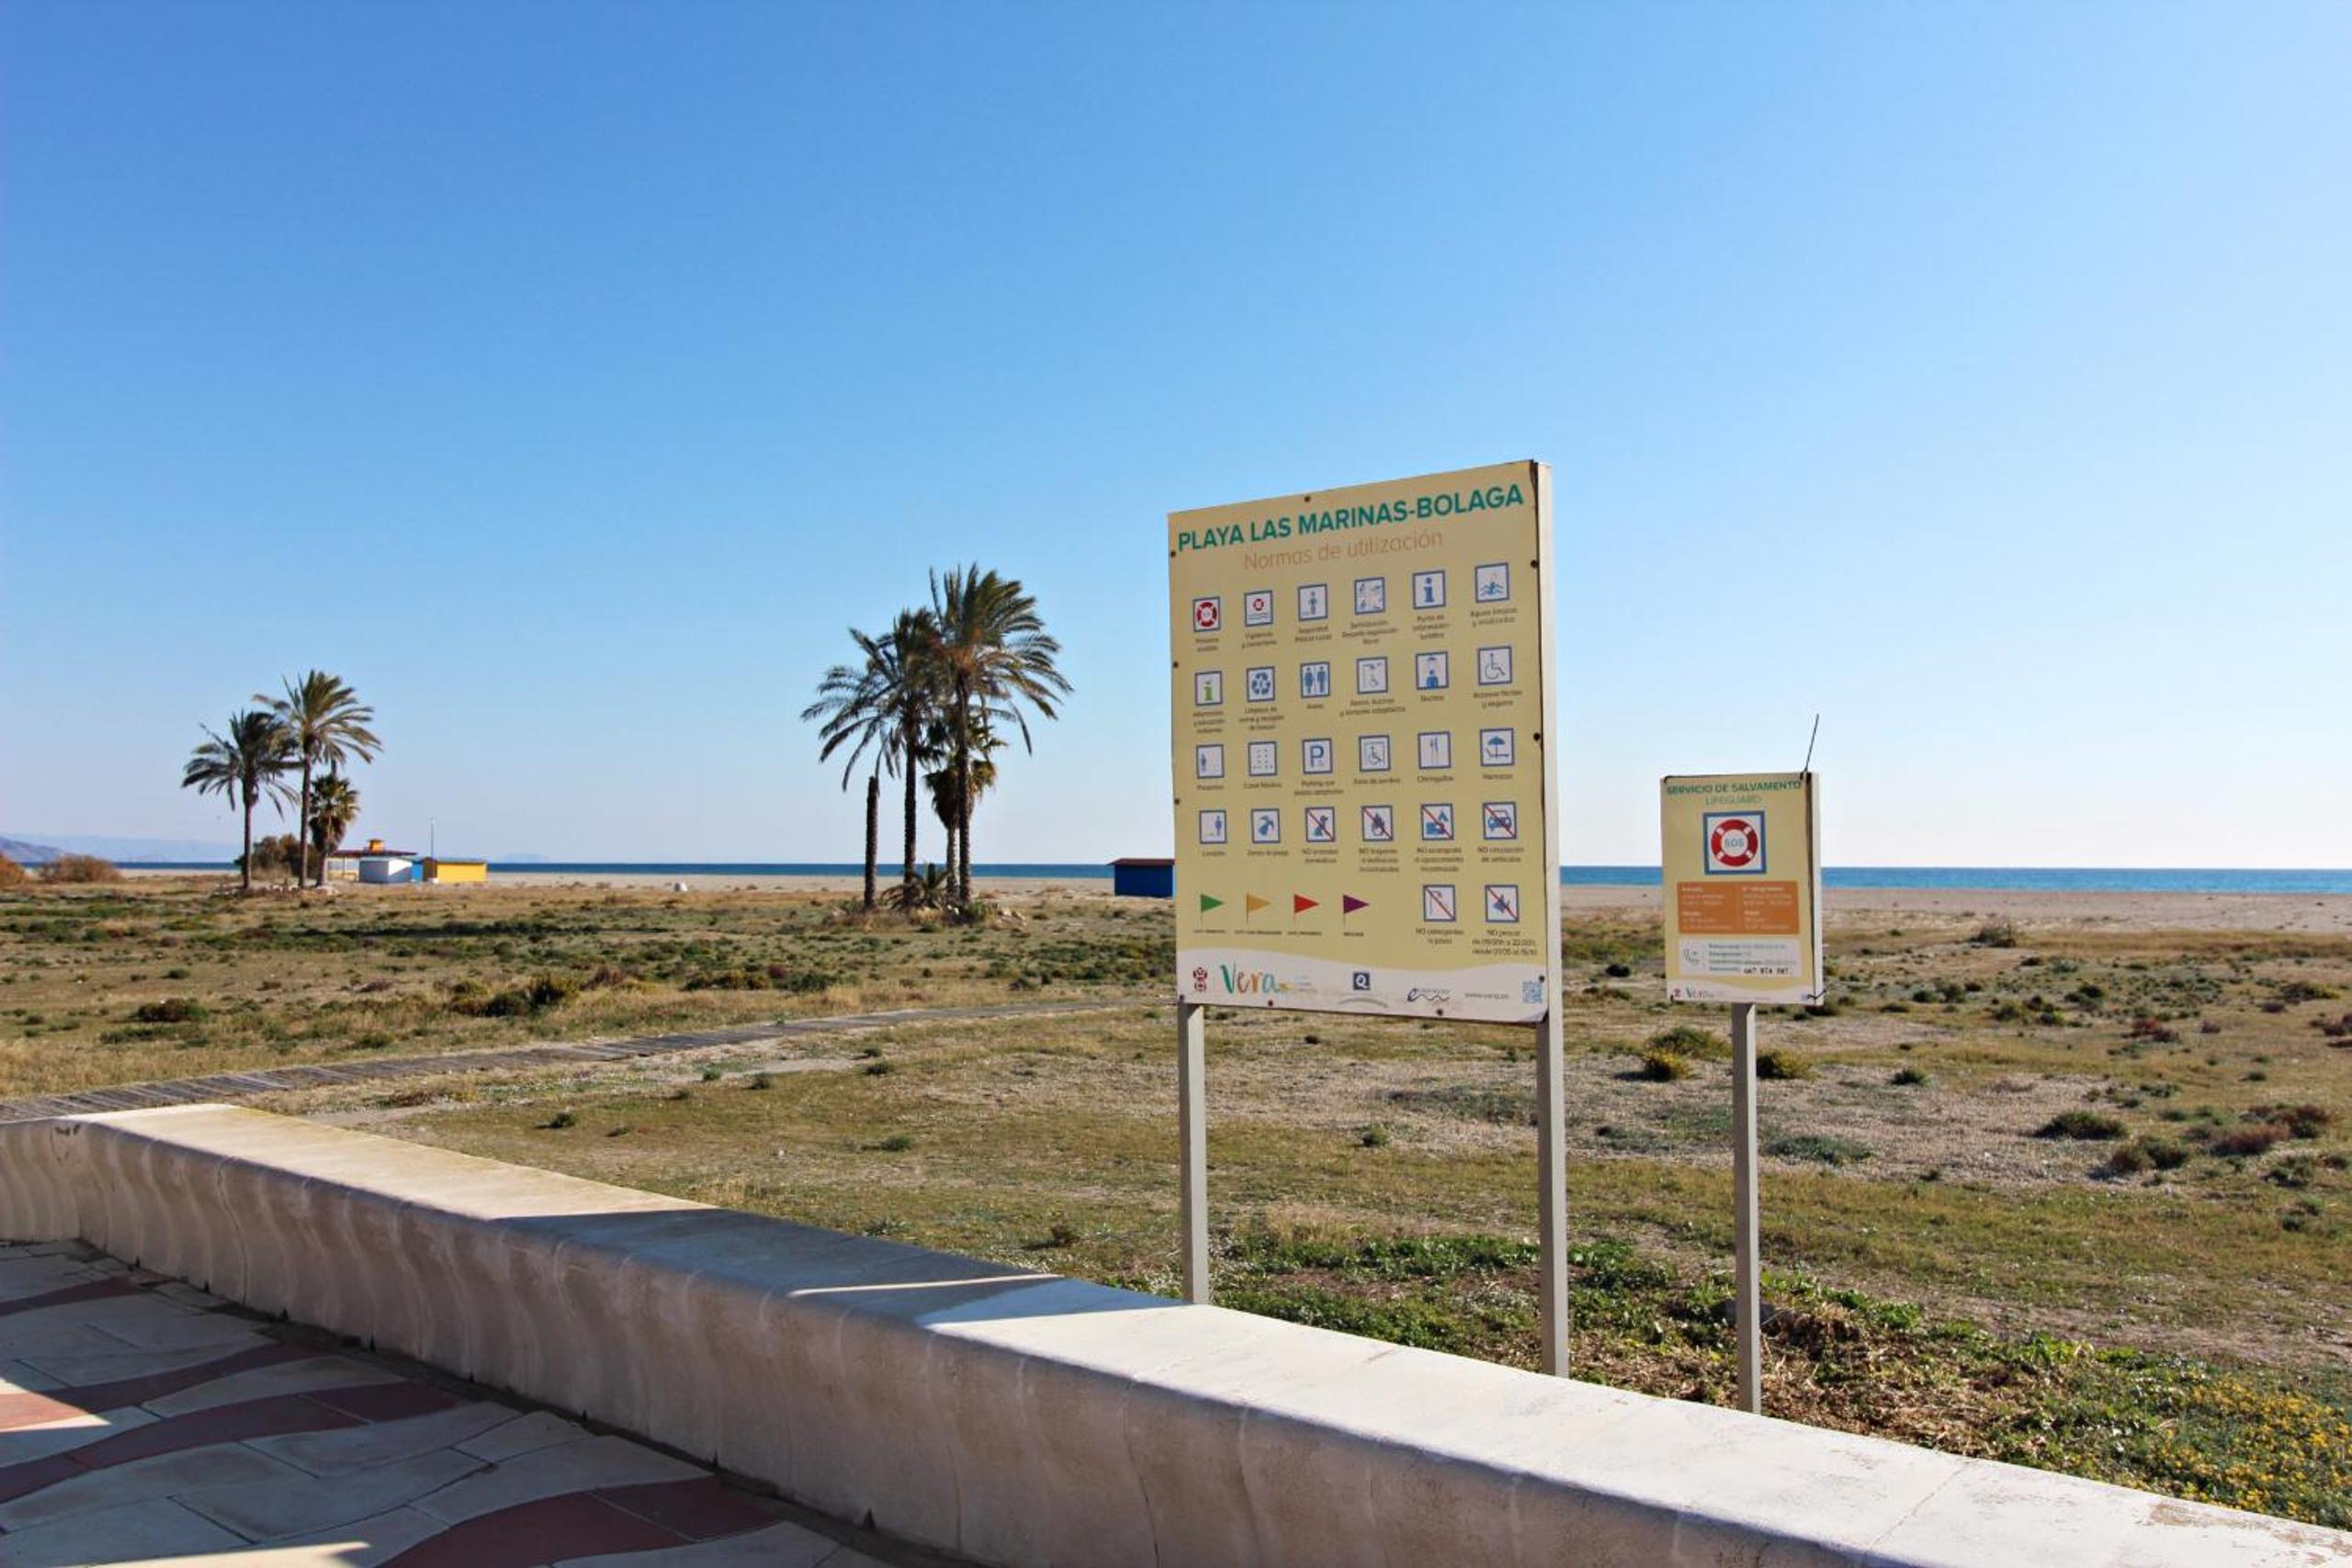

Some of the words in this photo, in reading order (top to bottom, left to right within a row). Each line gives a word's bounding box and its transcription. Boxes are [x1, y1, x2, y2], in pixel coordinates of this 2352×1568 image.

[1177, 523, 1244, 552] PLAYA
[1250, 516, 1292, 542] LAS
[1298, 484, 1524, 535] MARINAS-BOLAGA
[1244, 547, 1312, 570] Normas
[1318, 541, 1340, 562] de
[1347, 528, 1443, 558] utilización
[1667, 784, 1712, 795] SERVICIO
[1714, 783, 1728, 793] DE
[1732, 781, 1801, 793] SALVAMENTO
[1724, 838, 1744, 849] SOS
[1219, 960, 1281, 994] Vera
